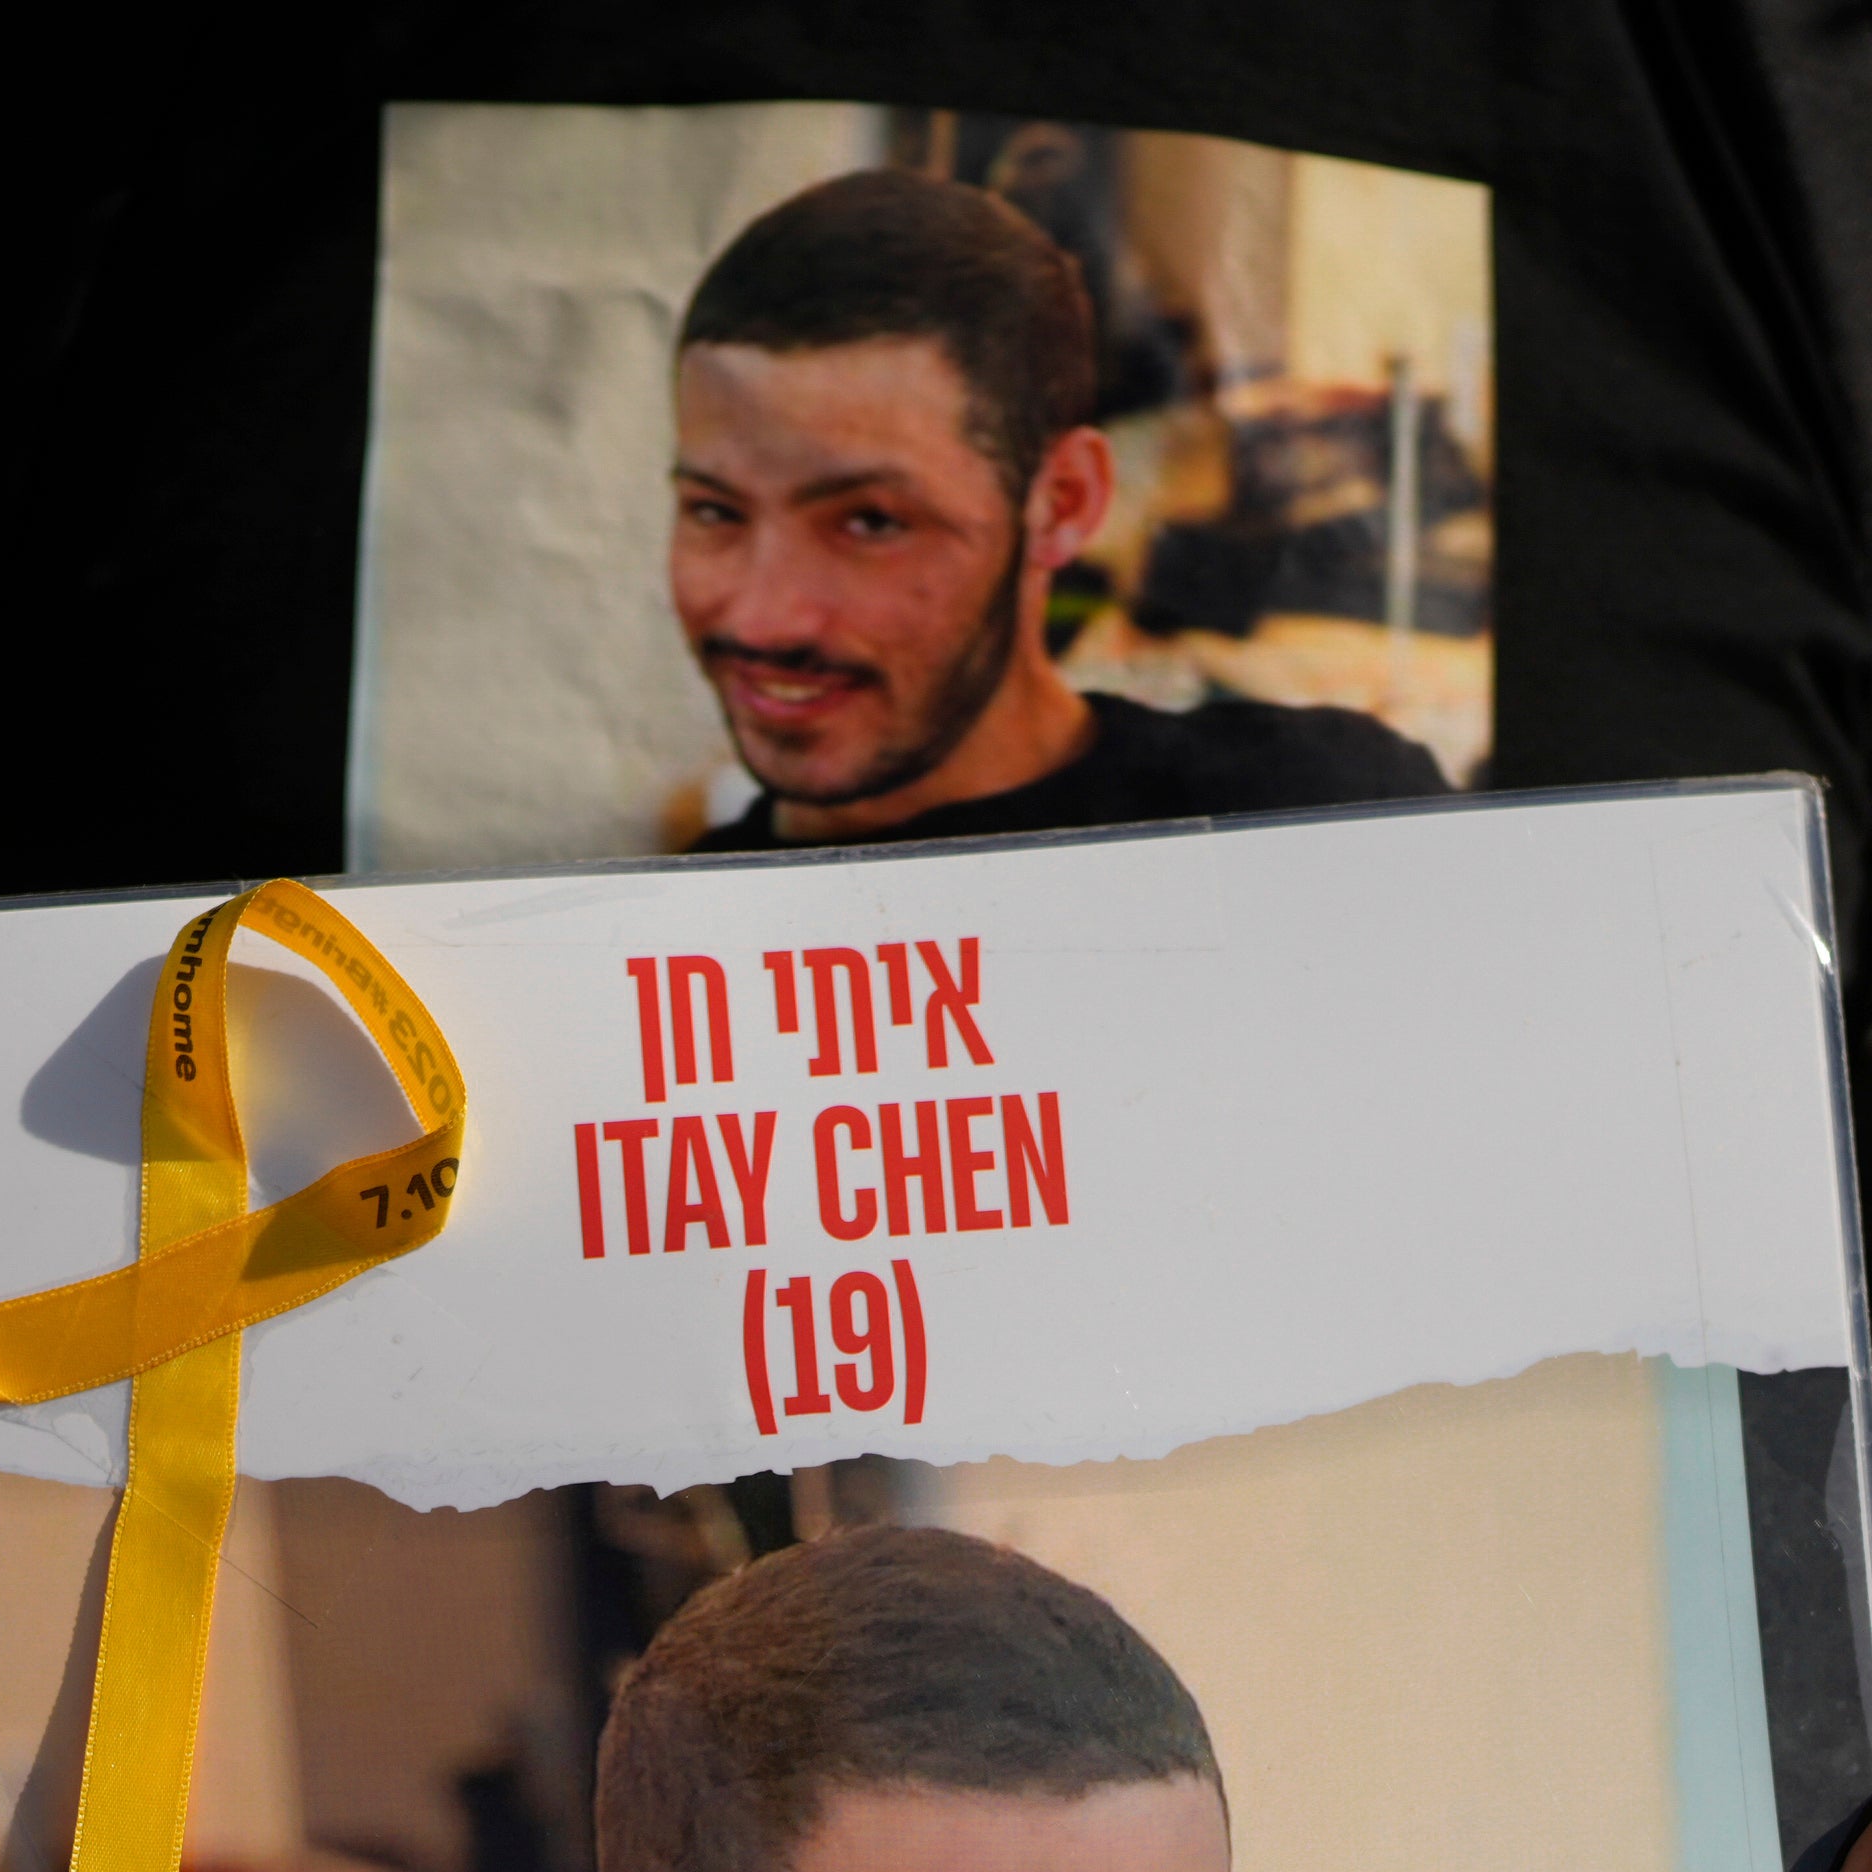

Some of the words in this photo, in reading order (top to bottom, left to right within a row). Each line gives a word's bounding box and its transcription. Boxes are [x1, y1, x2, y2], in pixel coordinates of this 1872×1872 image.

[626, 955, 734, 1103] חן
[763, 937, 995, 1077] איתי
[574, 1111, 777, 1260] ITAY
[813, 1091, 1070, 1241] CHEN
[743, 1258, 928, 1436] (19)
